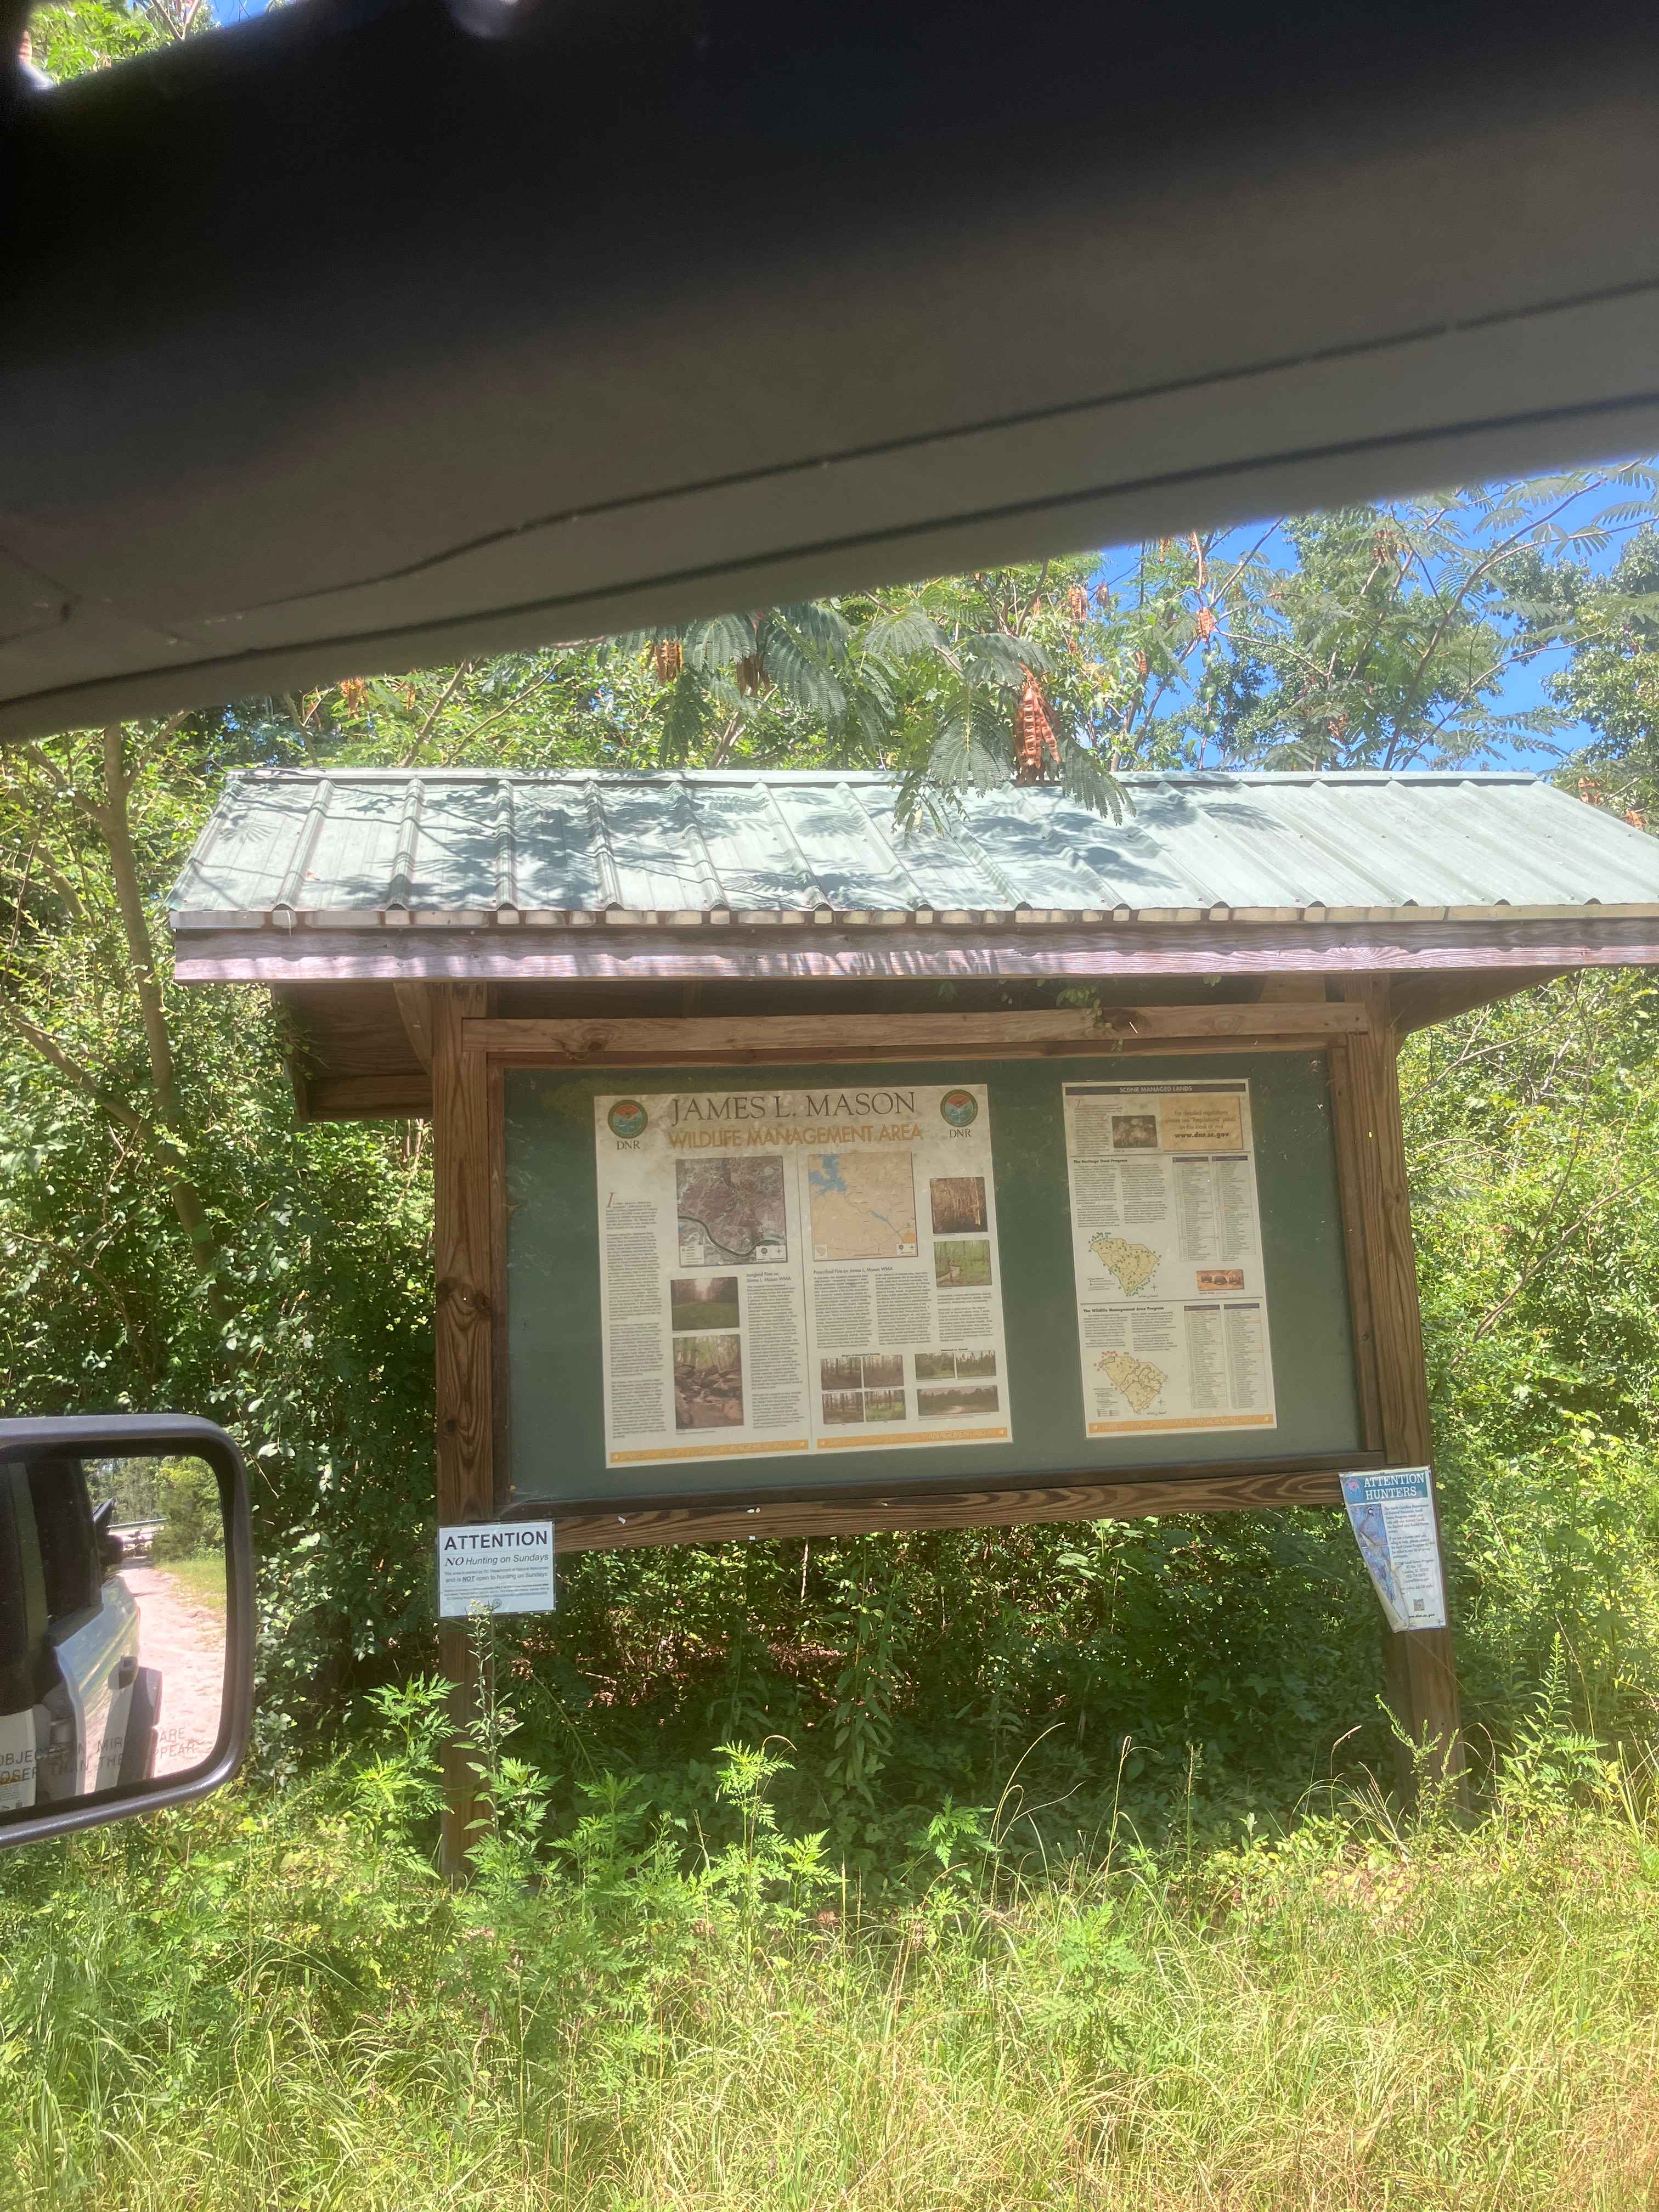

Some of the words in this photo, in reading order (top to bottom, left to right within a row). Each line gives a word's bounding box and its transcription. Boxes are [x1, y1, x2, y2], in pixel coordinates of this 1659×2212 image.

[672, 1097, 765, 1126] JAMES
[774, 1096, 796, 1119] L.
[806, 1092, 915, 1116] MASON
[667, 1130, 742, 1149] WILDLIFE
[746, 1125, 873, 1147] MANAGEMENT
[878, 1124, 924, 1142] AREA
[949, 1128, 971, 1138] DNR
[617, 1141, 641, 1150] DNR
[1364, 1473, 1425, 1488] ATTENTION
[1365, 1486, 1417, 1500] HUNTERS
[444, 1531, 548, 1550] ATTENTION
[444, 1557, 464, 1567] NO
[466, 1555, 498, 1565] Hunting
[513, 1554, 549, 1563] Sundays
[160, 1728, 185, 1742] ARE
